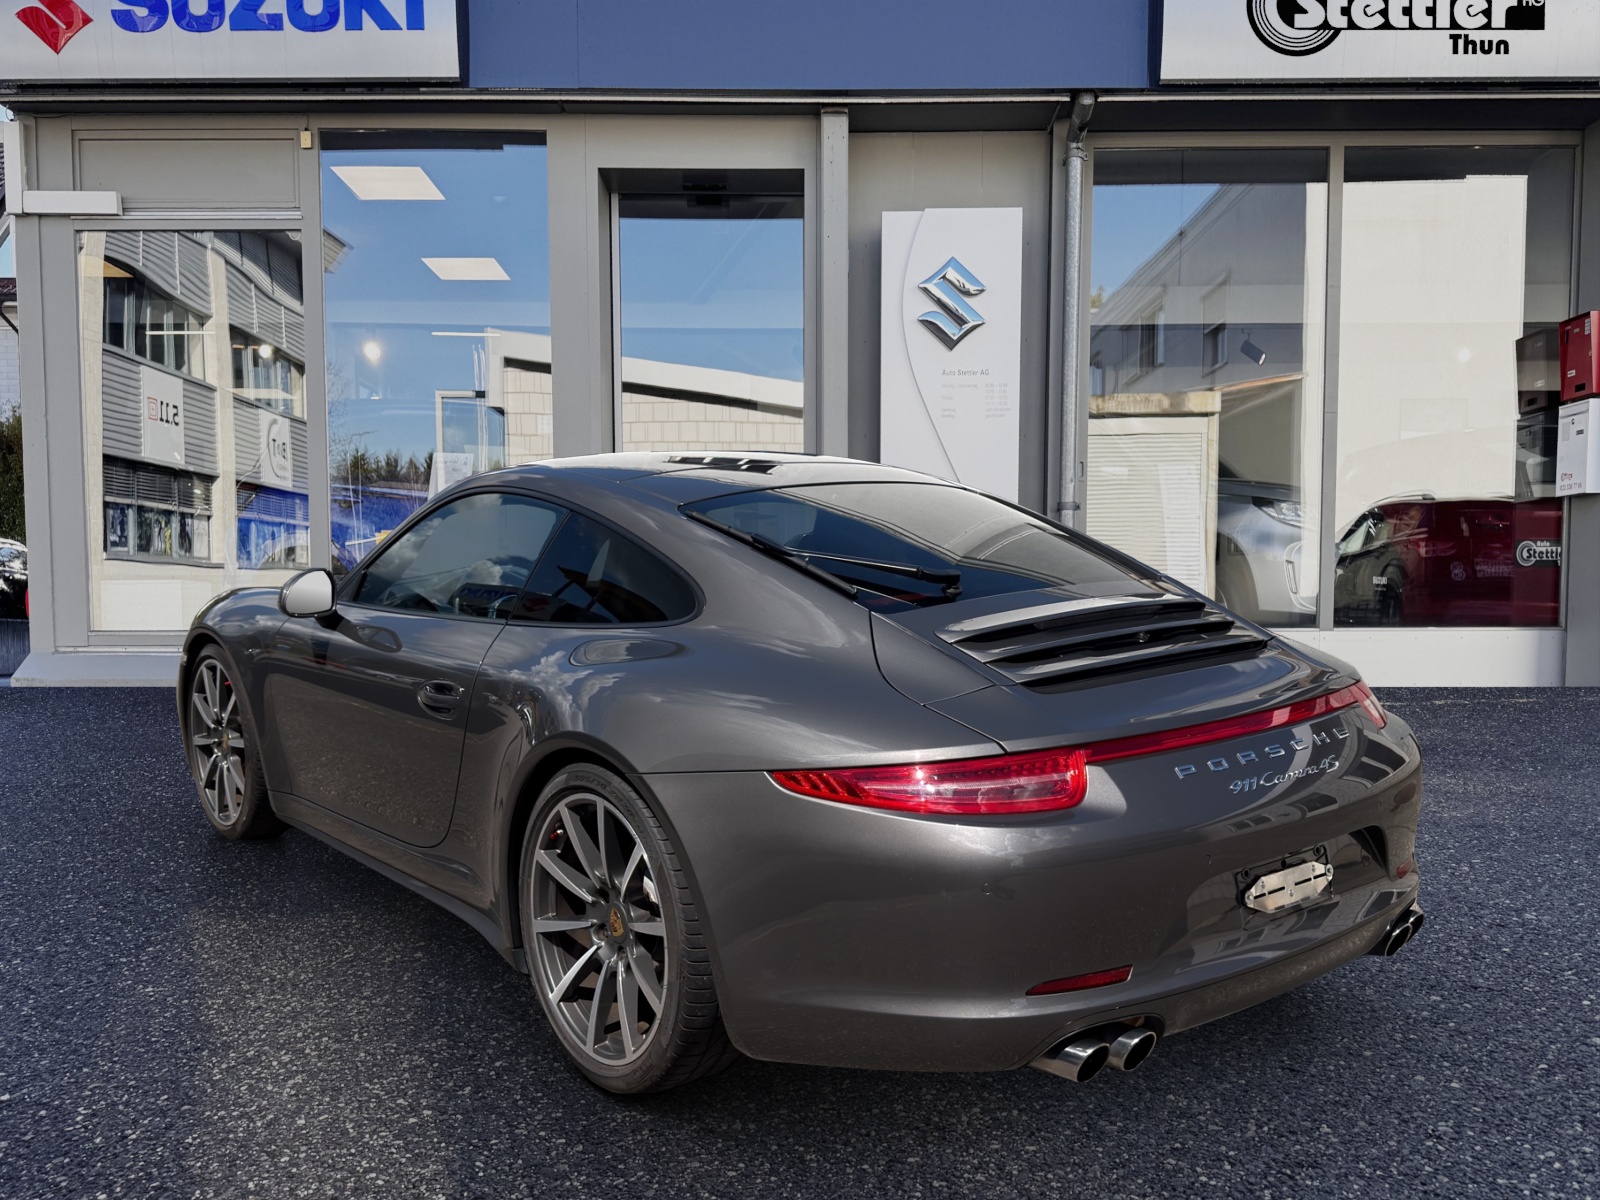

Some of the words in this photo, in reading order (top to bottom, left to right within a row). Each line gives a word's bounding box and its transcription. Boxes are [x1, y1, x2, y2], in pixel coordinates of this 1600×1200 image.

[110, 0, 425, 33] SUZUKI
[1294, 0, 1518, 29] Stettler
[1449, 34, 1509, 55] Thun
[980, 368, 990, 376] AG
[1525, 547, 1561, 560] Stettl
[1174, 728, 1350, 779] PORSCHE
[1229, 776, 1258, 794] 911
[1317, 754, 1340, 773] 4S
